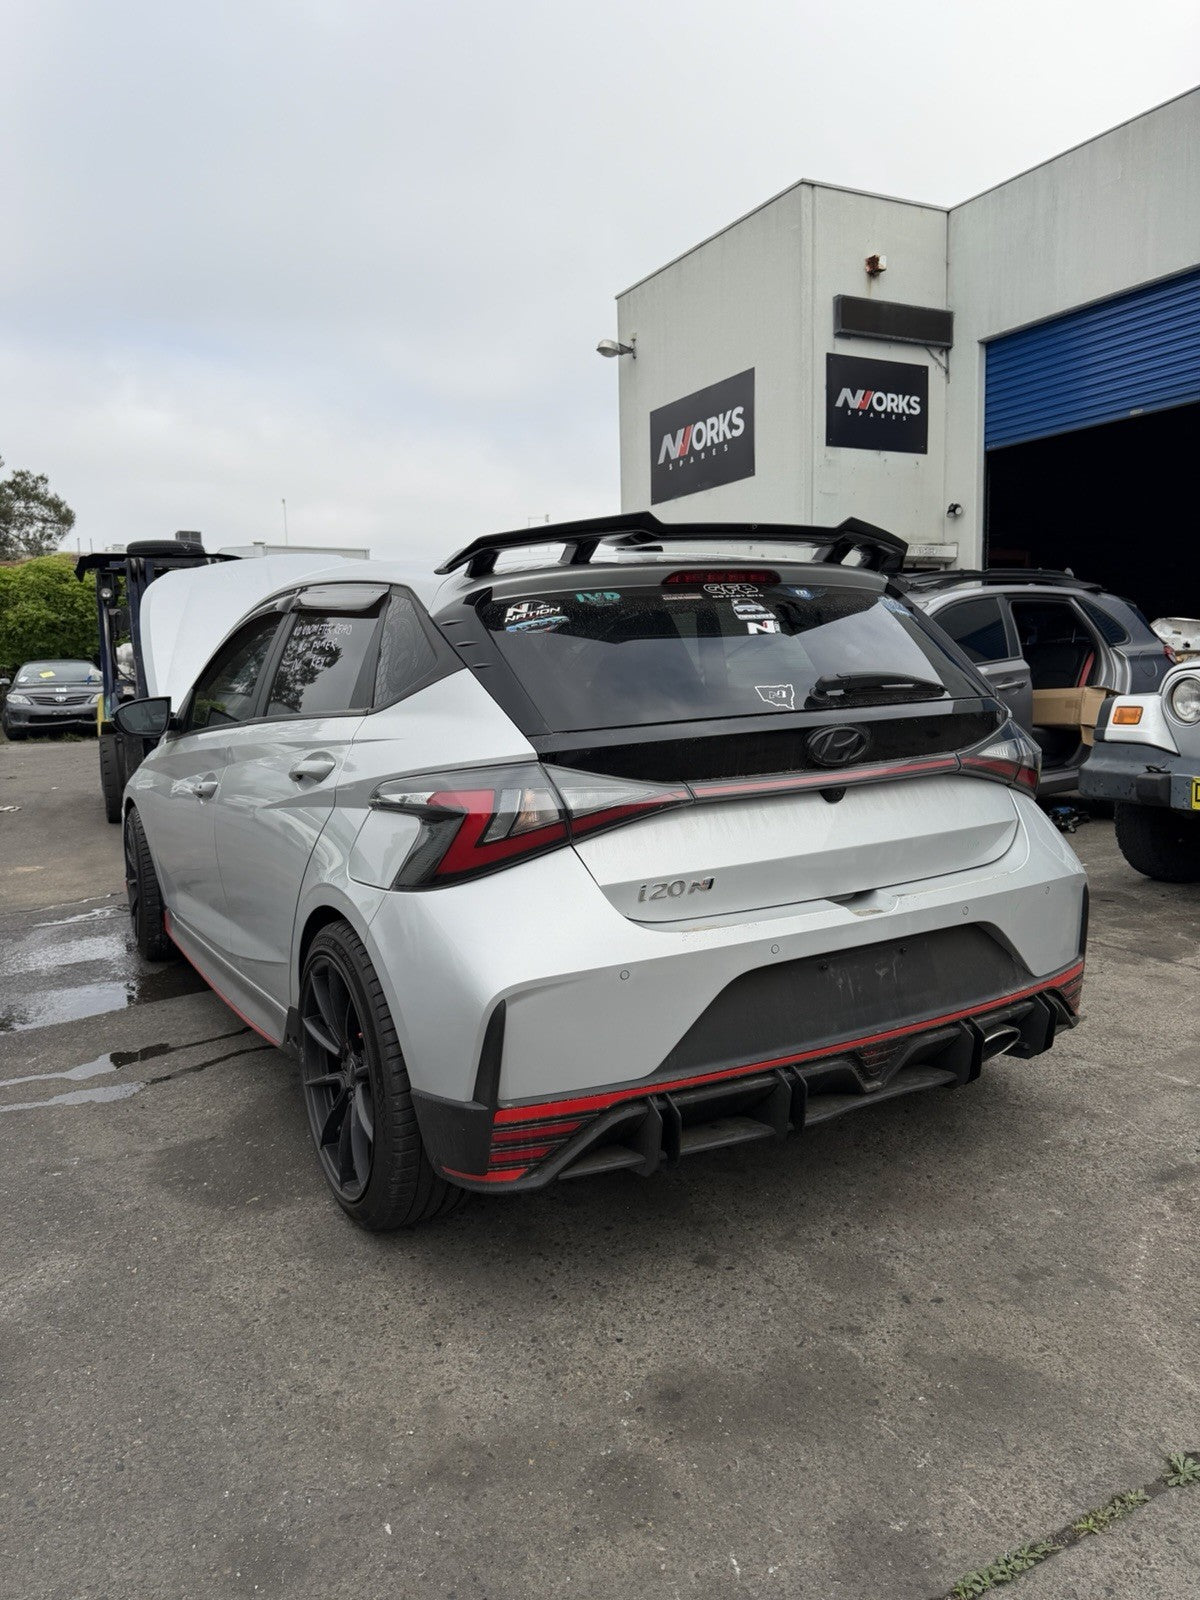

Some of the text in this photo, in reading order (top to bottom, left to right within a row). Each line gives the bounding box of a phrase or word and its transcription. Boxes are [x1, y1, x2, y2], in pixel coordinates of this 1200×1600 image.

[847, 409, 907, 422] SPARES
[668, 443, 728, 471] SPARES
[504, 606, 561, 623] NATION
